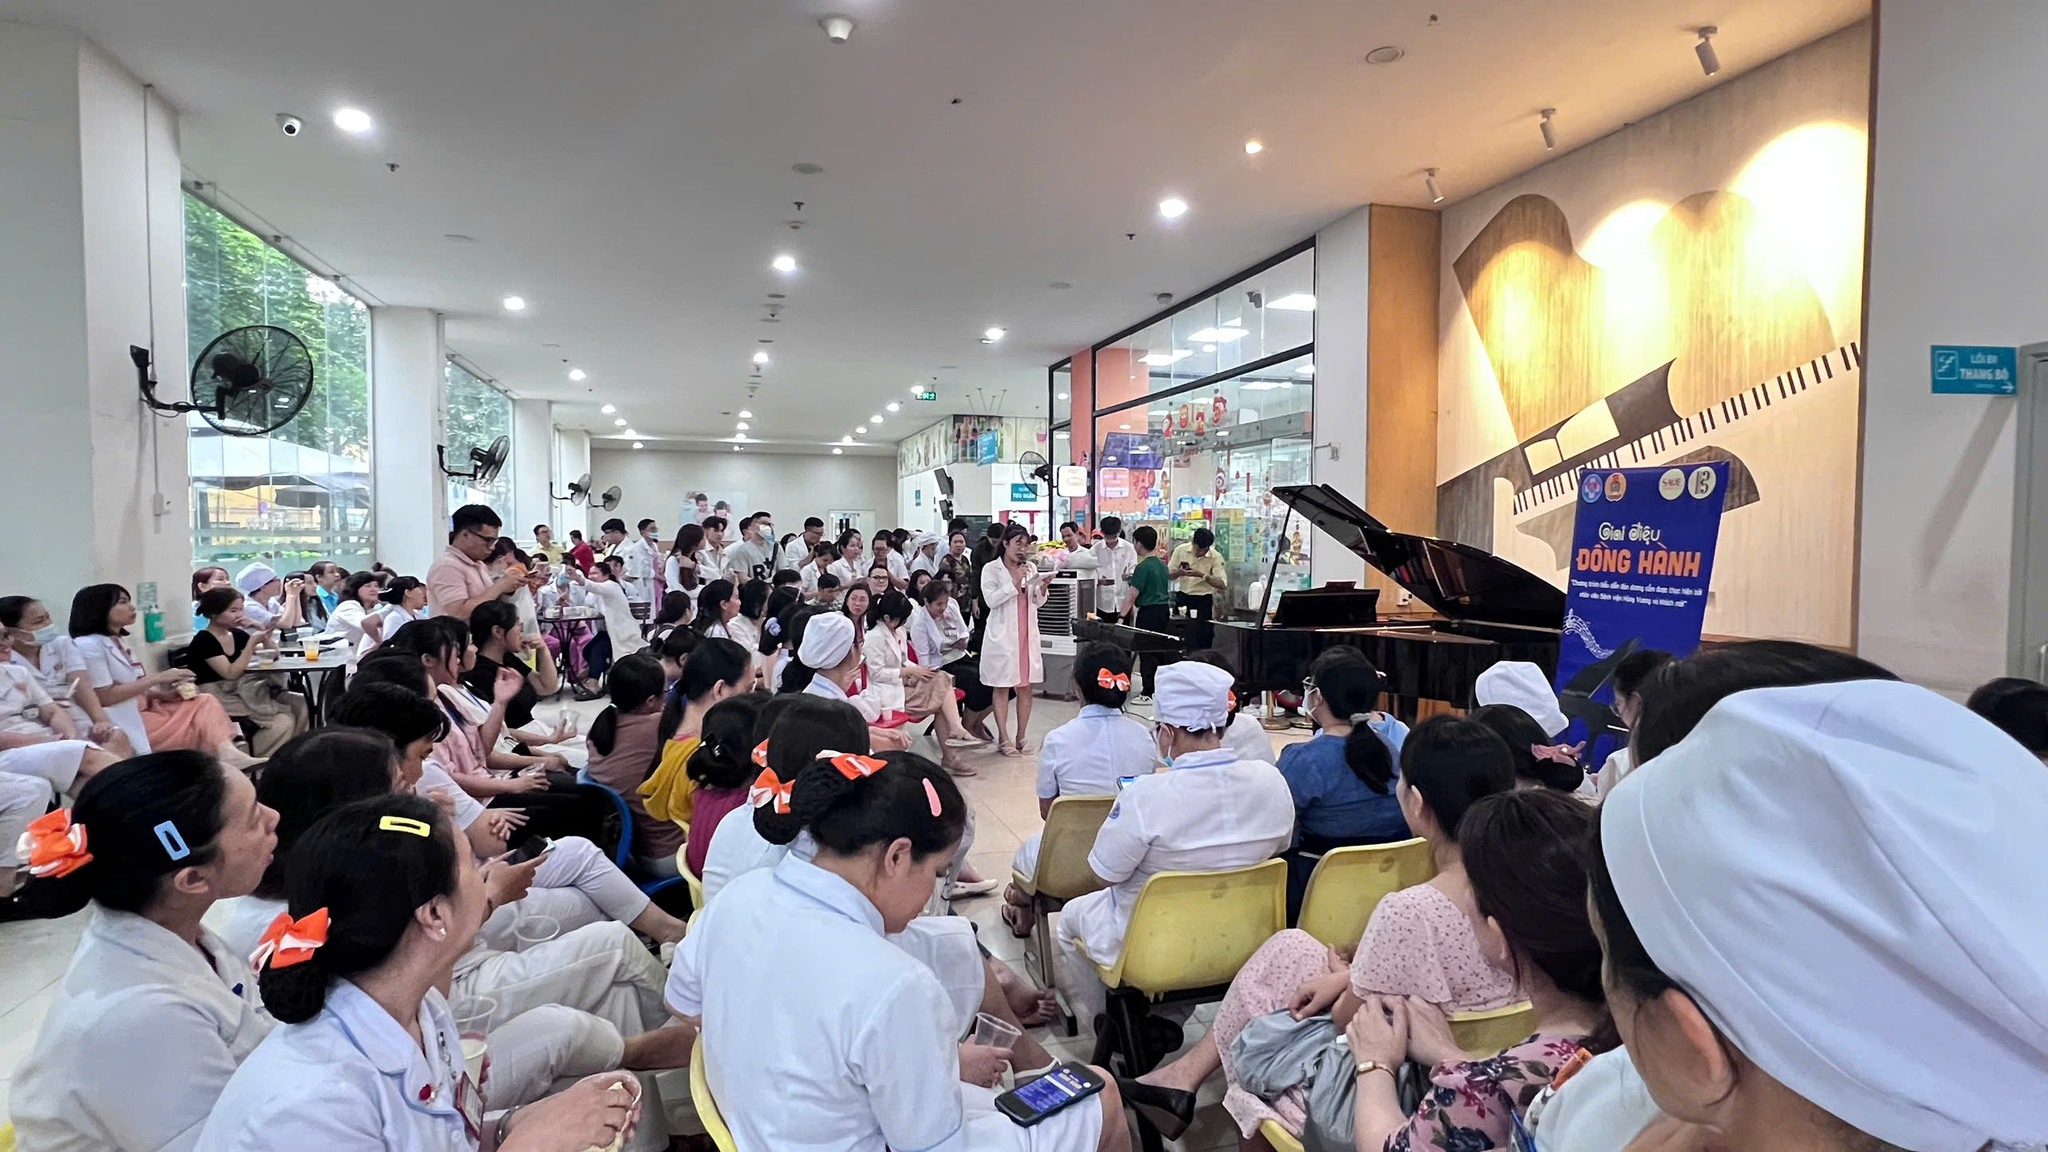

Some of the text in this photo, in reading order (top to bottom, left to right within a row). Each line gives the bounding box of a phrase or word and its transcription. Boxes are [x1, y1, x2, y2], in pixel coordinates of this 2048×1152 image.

[1959, 368, 1994, 380] THANG
[1599, 522, 1661, 545] Giai điệu
[1577, 541, 1701, 577] ĐỒNG HÀNH
